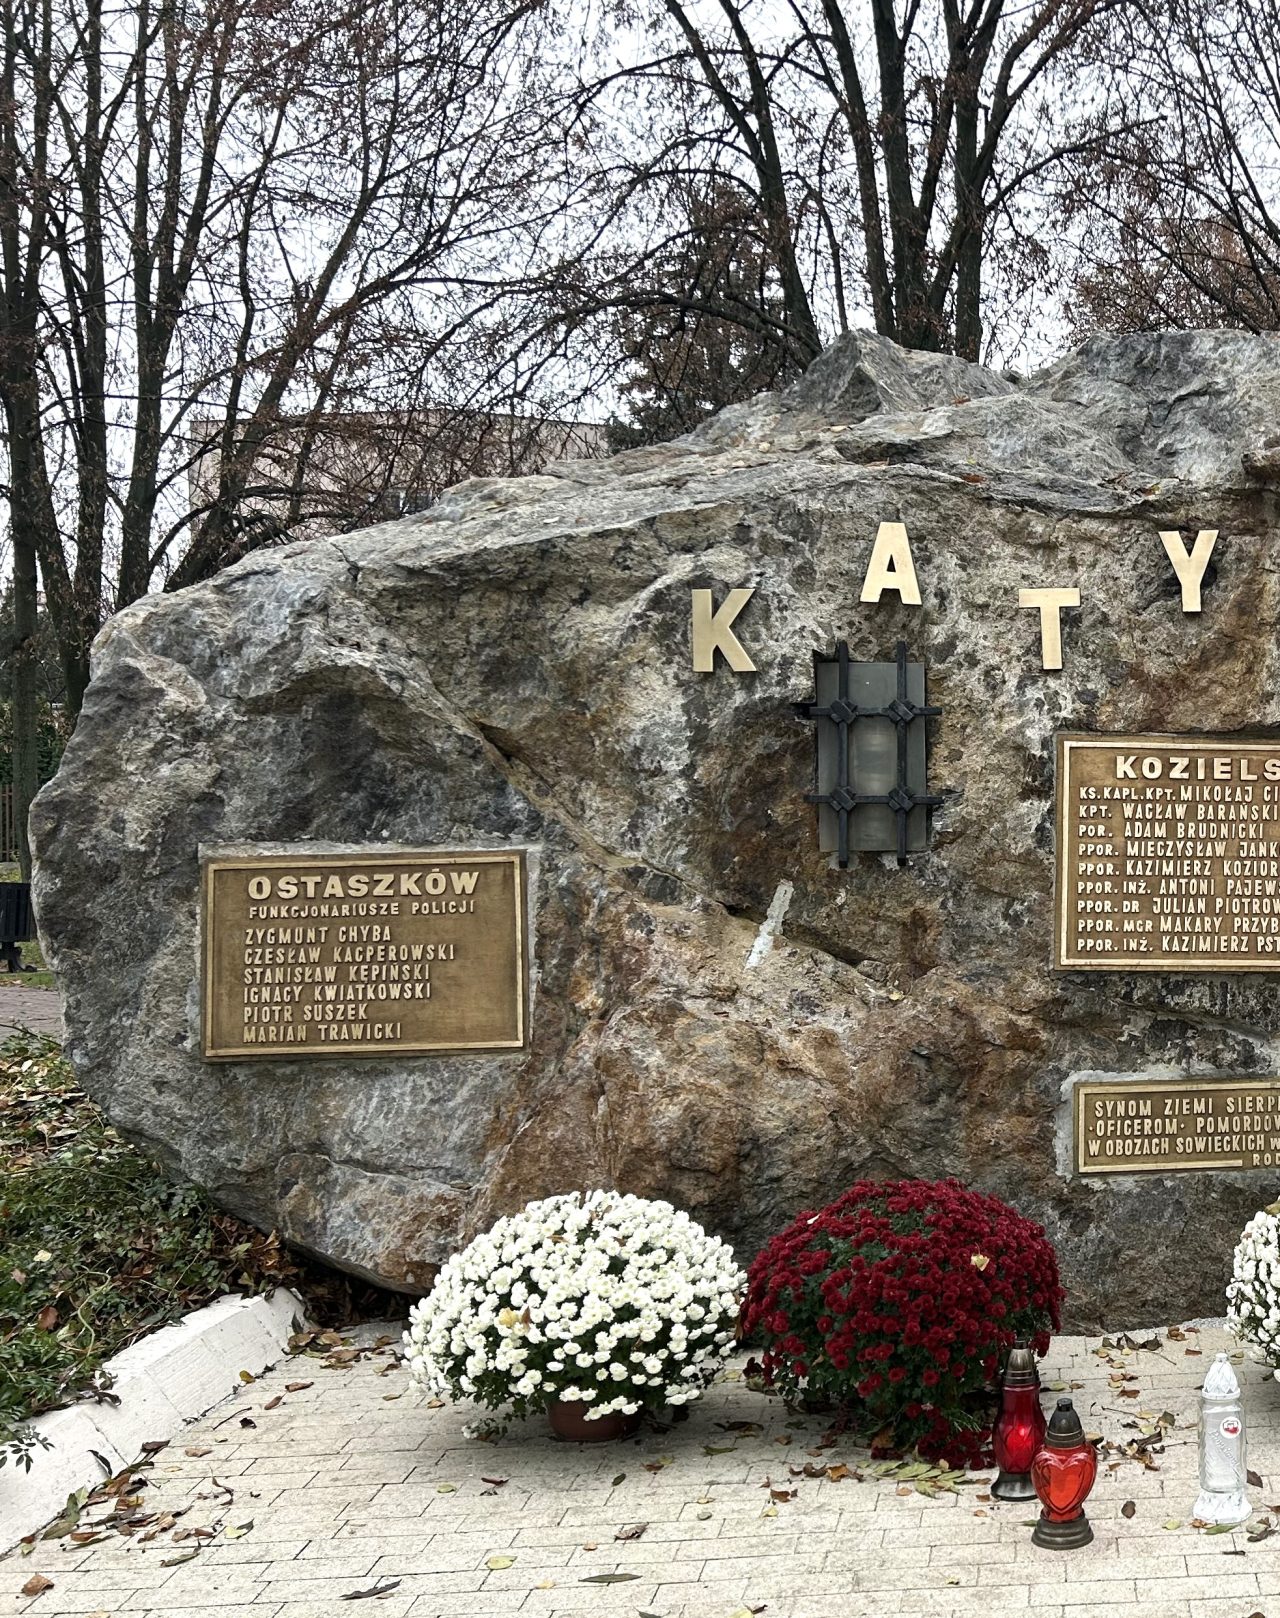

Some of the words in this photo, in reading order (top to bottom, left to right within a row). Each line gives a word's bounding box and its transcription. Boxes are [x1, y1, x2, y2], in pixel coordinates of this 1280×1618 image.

[1079, 805, 1112, 817] KPT.
[1123, 803, 1187, 819] WACŁAW
[1197, 803, 1278, 821] BARAŃSKI
[1079, 825, 1113, 837] POR.
[1125, 822, 1167, 838] ADAM
[1177, 823, 1263, 839] BRUDNICKI
[1079, 844, 1119, 856] PPOR.
[1127, 841, 1226, 857] MIECZYSŁAW
[1079, 863, 1119, 875] PPOR.
[1126, 860, 1211, 876] KAZIMIERZ
[249, 869, 479, 899] OSTASZKÓW
[1160, 879, 1215, 895] ANTONI
[250, 902, 399, 919] FUNKCJONARIUSZE
[412, 900, 475, 915] POLICJI
[1153, 898, 1206, 913] JULIAN
[1160, 916, 1222, 932] MAKARY
[245, 927, 328, 944] ZYGMUNT
[339, 926, 391, 942] CHYBA
[1162, 936, 1248, 952] KAZIMIERZ
[244, 947, 321, 965] CZESŁAW
[333, 944, 455, 963] KACPEROWSKI
[244, 966, 337, 984] STANISŁAW
[349, 962, 429, 984] KĘPIŃSKI
[244, 986, 301, 1003] IGNACY
[315, 983, 431, 1001] KWIATKOWSKI
[244, 1005, 293, 1023] PIOTR
[304, 1004, 368, 1021] SUSZEK
[243, 1025, 307, 1043] MARIAN
[318, 1023, 401, 1040] TRAWICKI
[1095, 1100, 1152, 1117] SYNOM
[1164, 1098, 1213, 1115] ZIEMI
[1106, 1138, 1168, 1156] OBOZACH
[1176, 1135, 1264, 1153] SOWIECKICH
